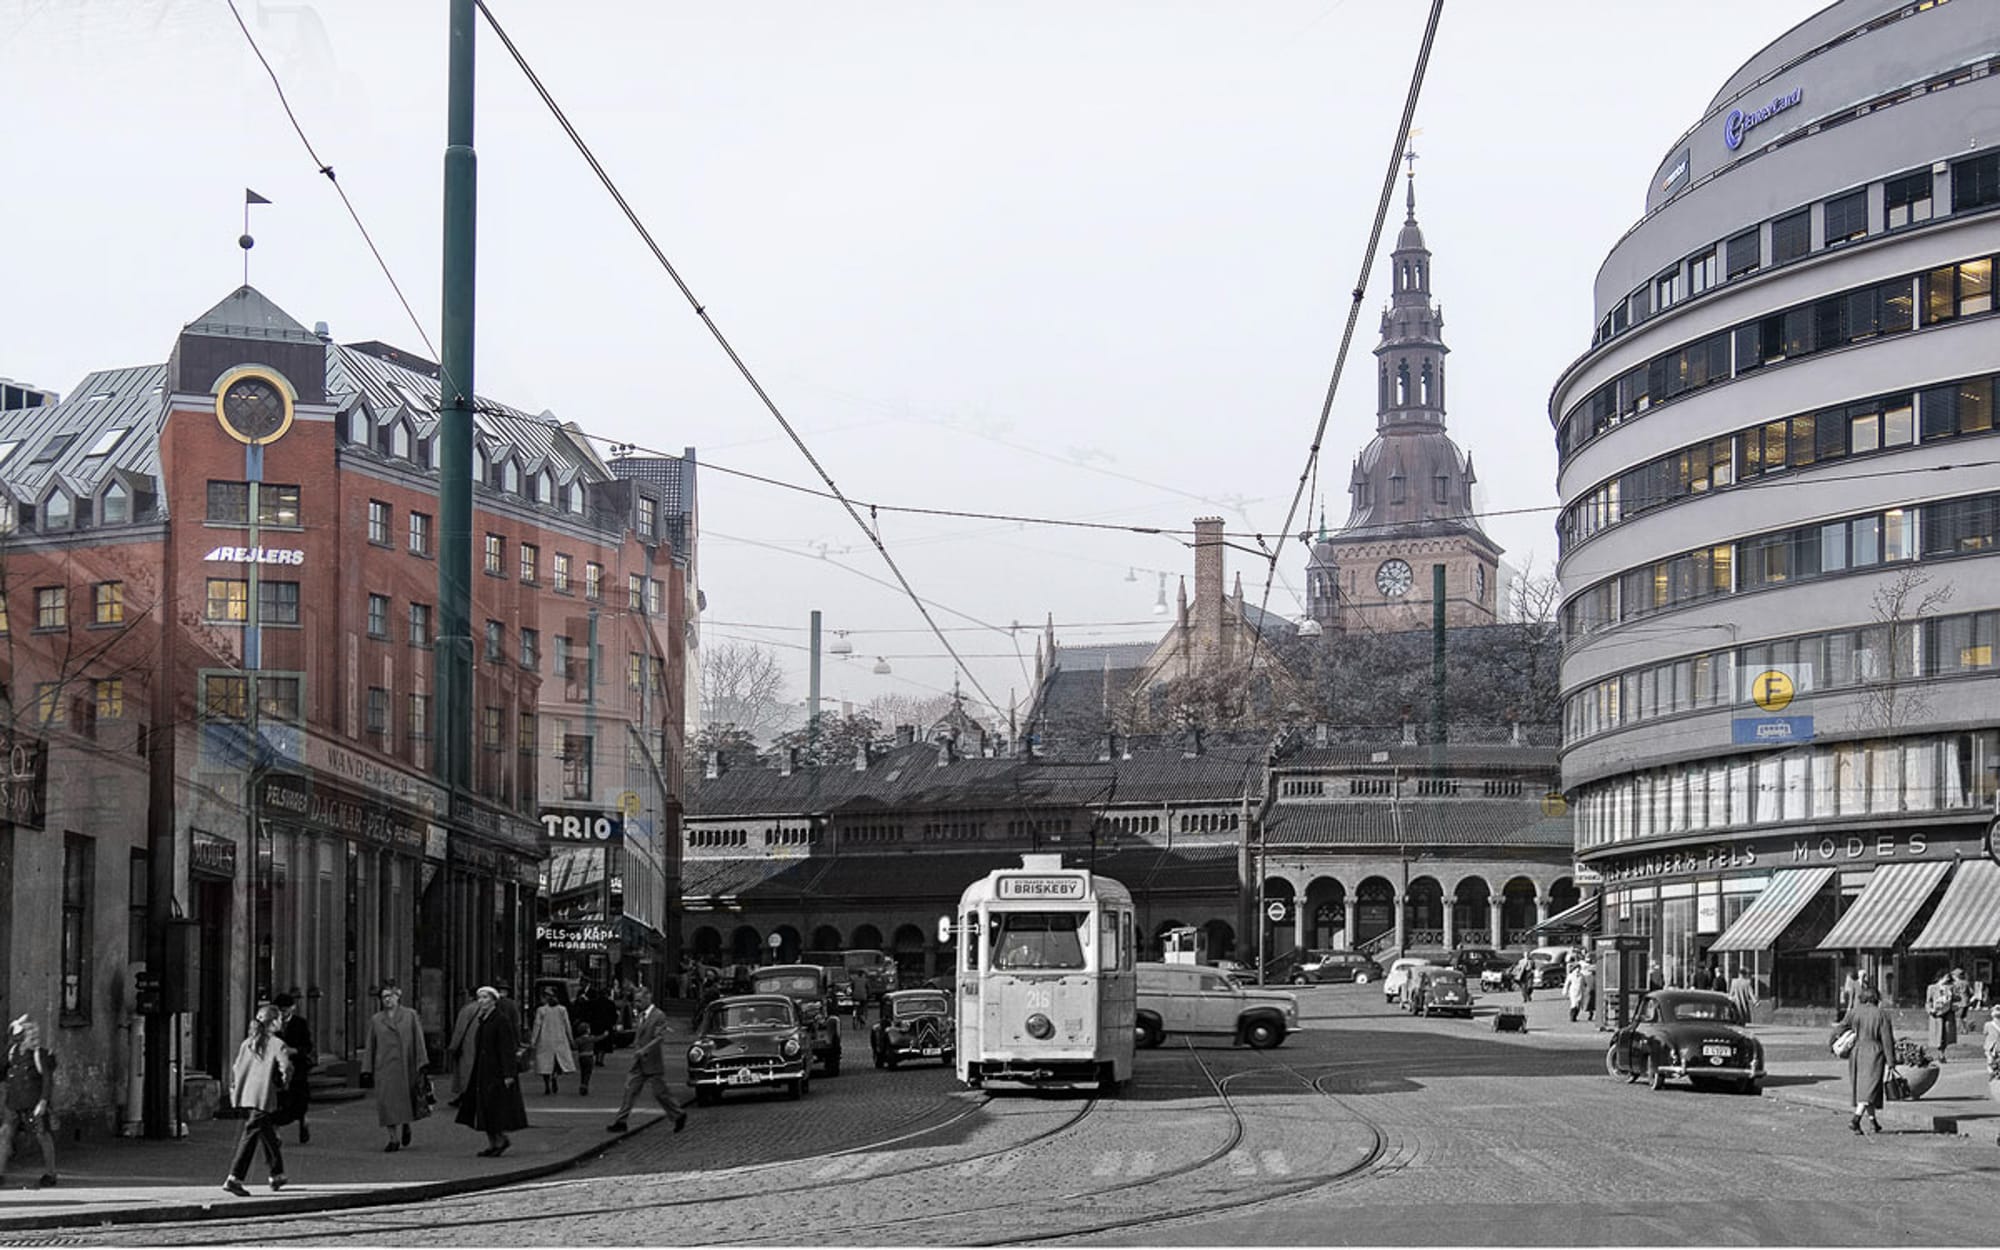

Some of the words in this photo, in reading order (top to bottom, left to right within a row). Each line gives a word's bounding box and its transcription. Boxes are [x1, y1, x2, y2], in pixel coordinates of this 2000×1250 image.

[219, 546, 305, 566] REJLERS
[540, 814, 612, 840] TRIO
[1706, 845, 1757, 870] PELS
[1792, 832, 1928, 863] MODES
[1014, 884, 1077, 894] BRISKEBY
